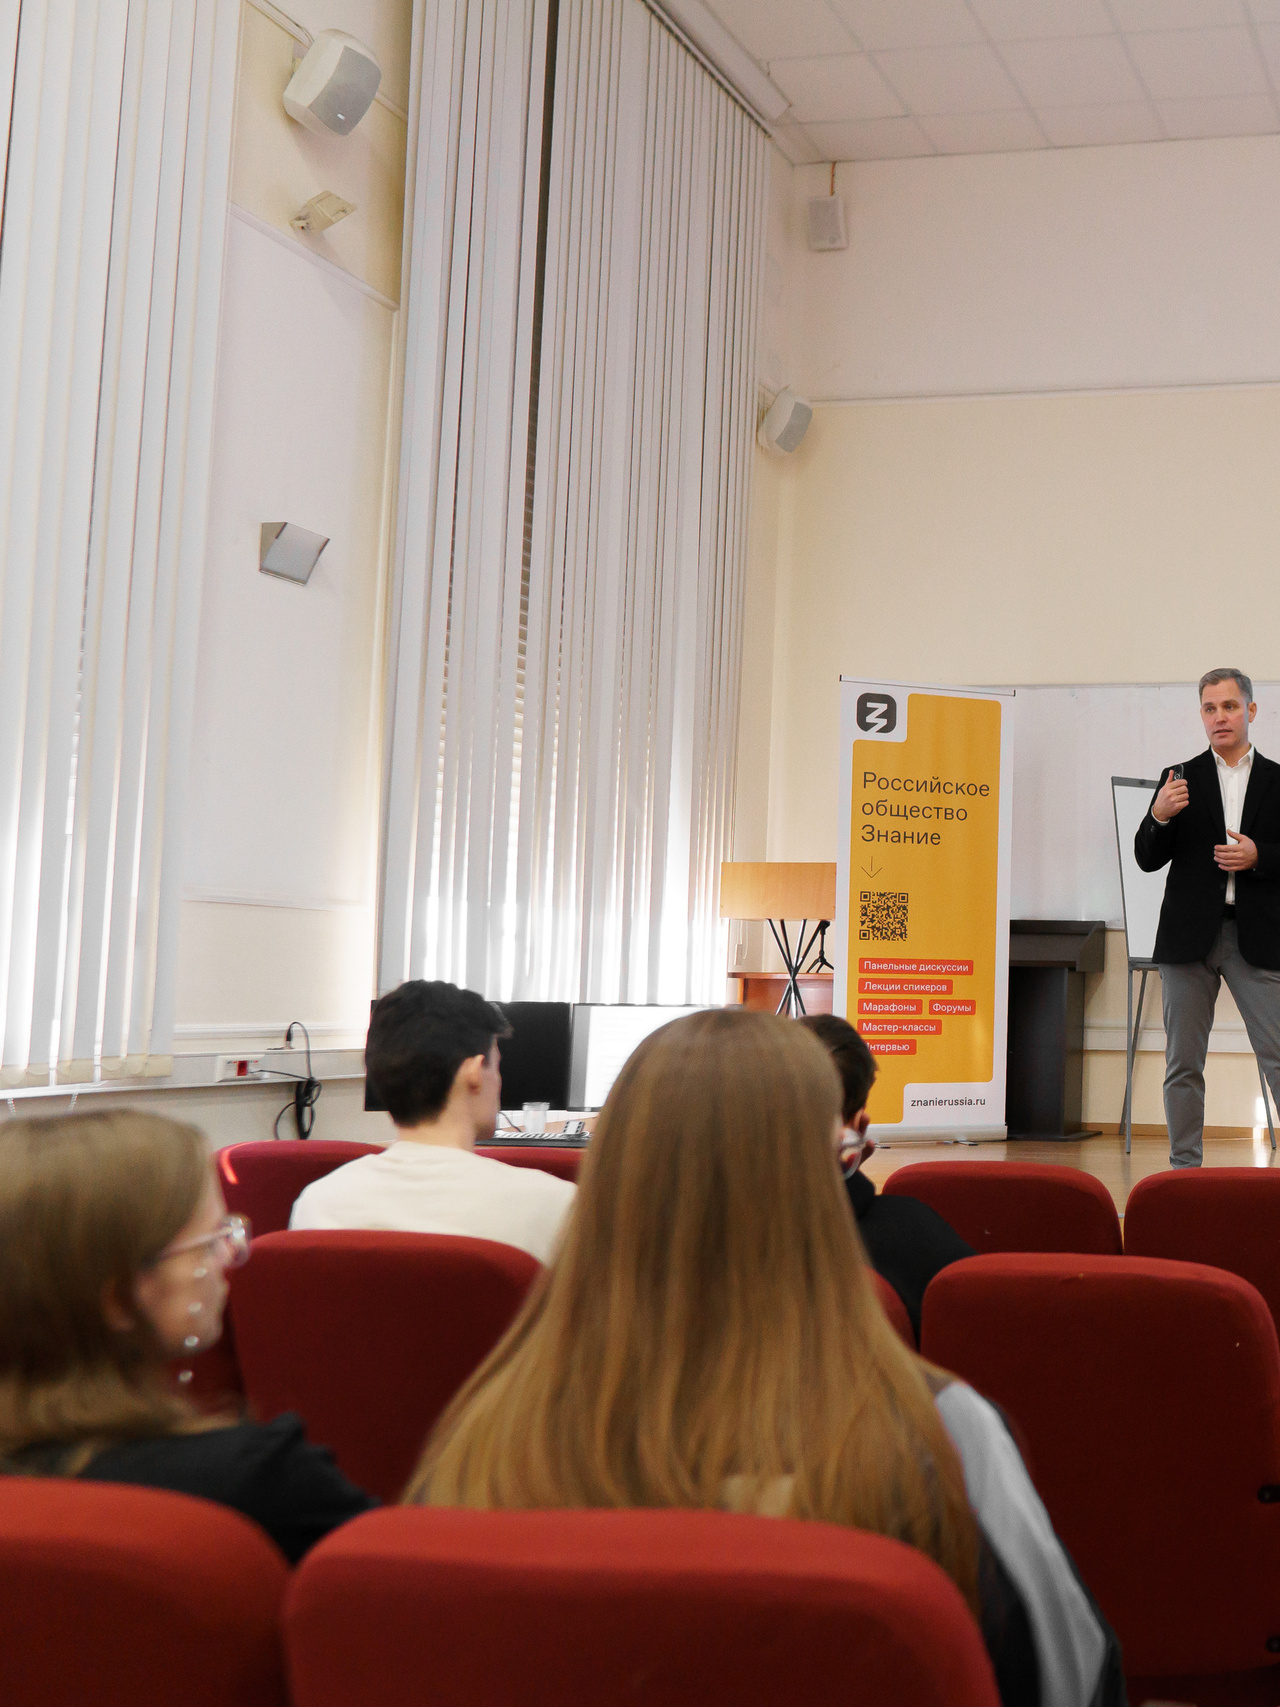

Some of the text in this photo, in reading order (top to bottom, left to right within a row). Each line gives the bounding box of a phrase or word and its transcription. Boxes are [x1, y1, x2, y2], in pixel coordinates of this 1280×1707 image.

[863, 771, 990, 797] Российское
[861, 799, 968, 821] общество
[861, 824, 941, 845] Знание
[863, 961, 969, 973] Панельные дискуссии
[863, 981, 947, 993] Лекции спикеров
[862, 1002, 916, 1013] Марафоны
[932, 1002, 972, 1013] Форумы
[862, 1022, 936, 1032] Мастер-классы
[910, 1096, 986, 1107] znanierussia.ru
